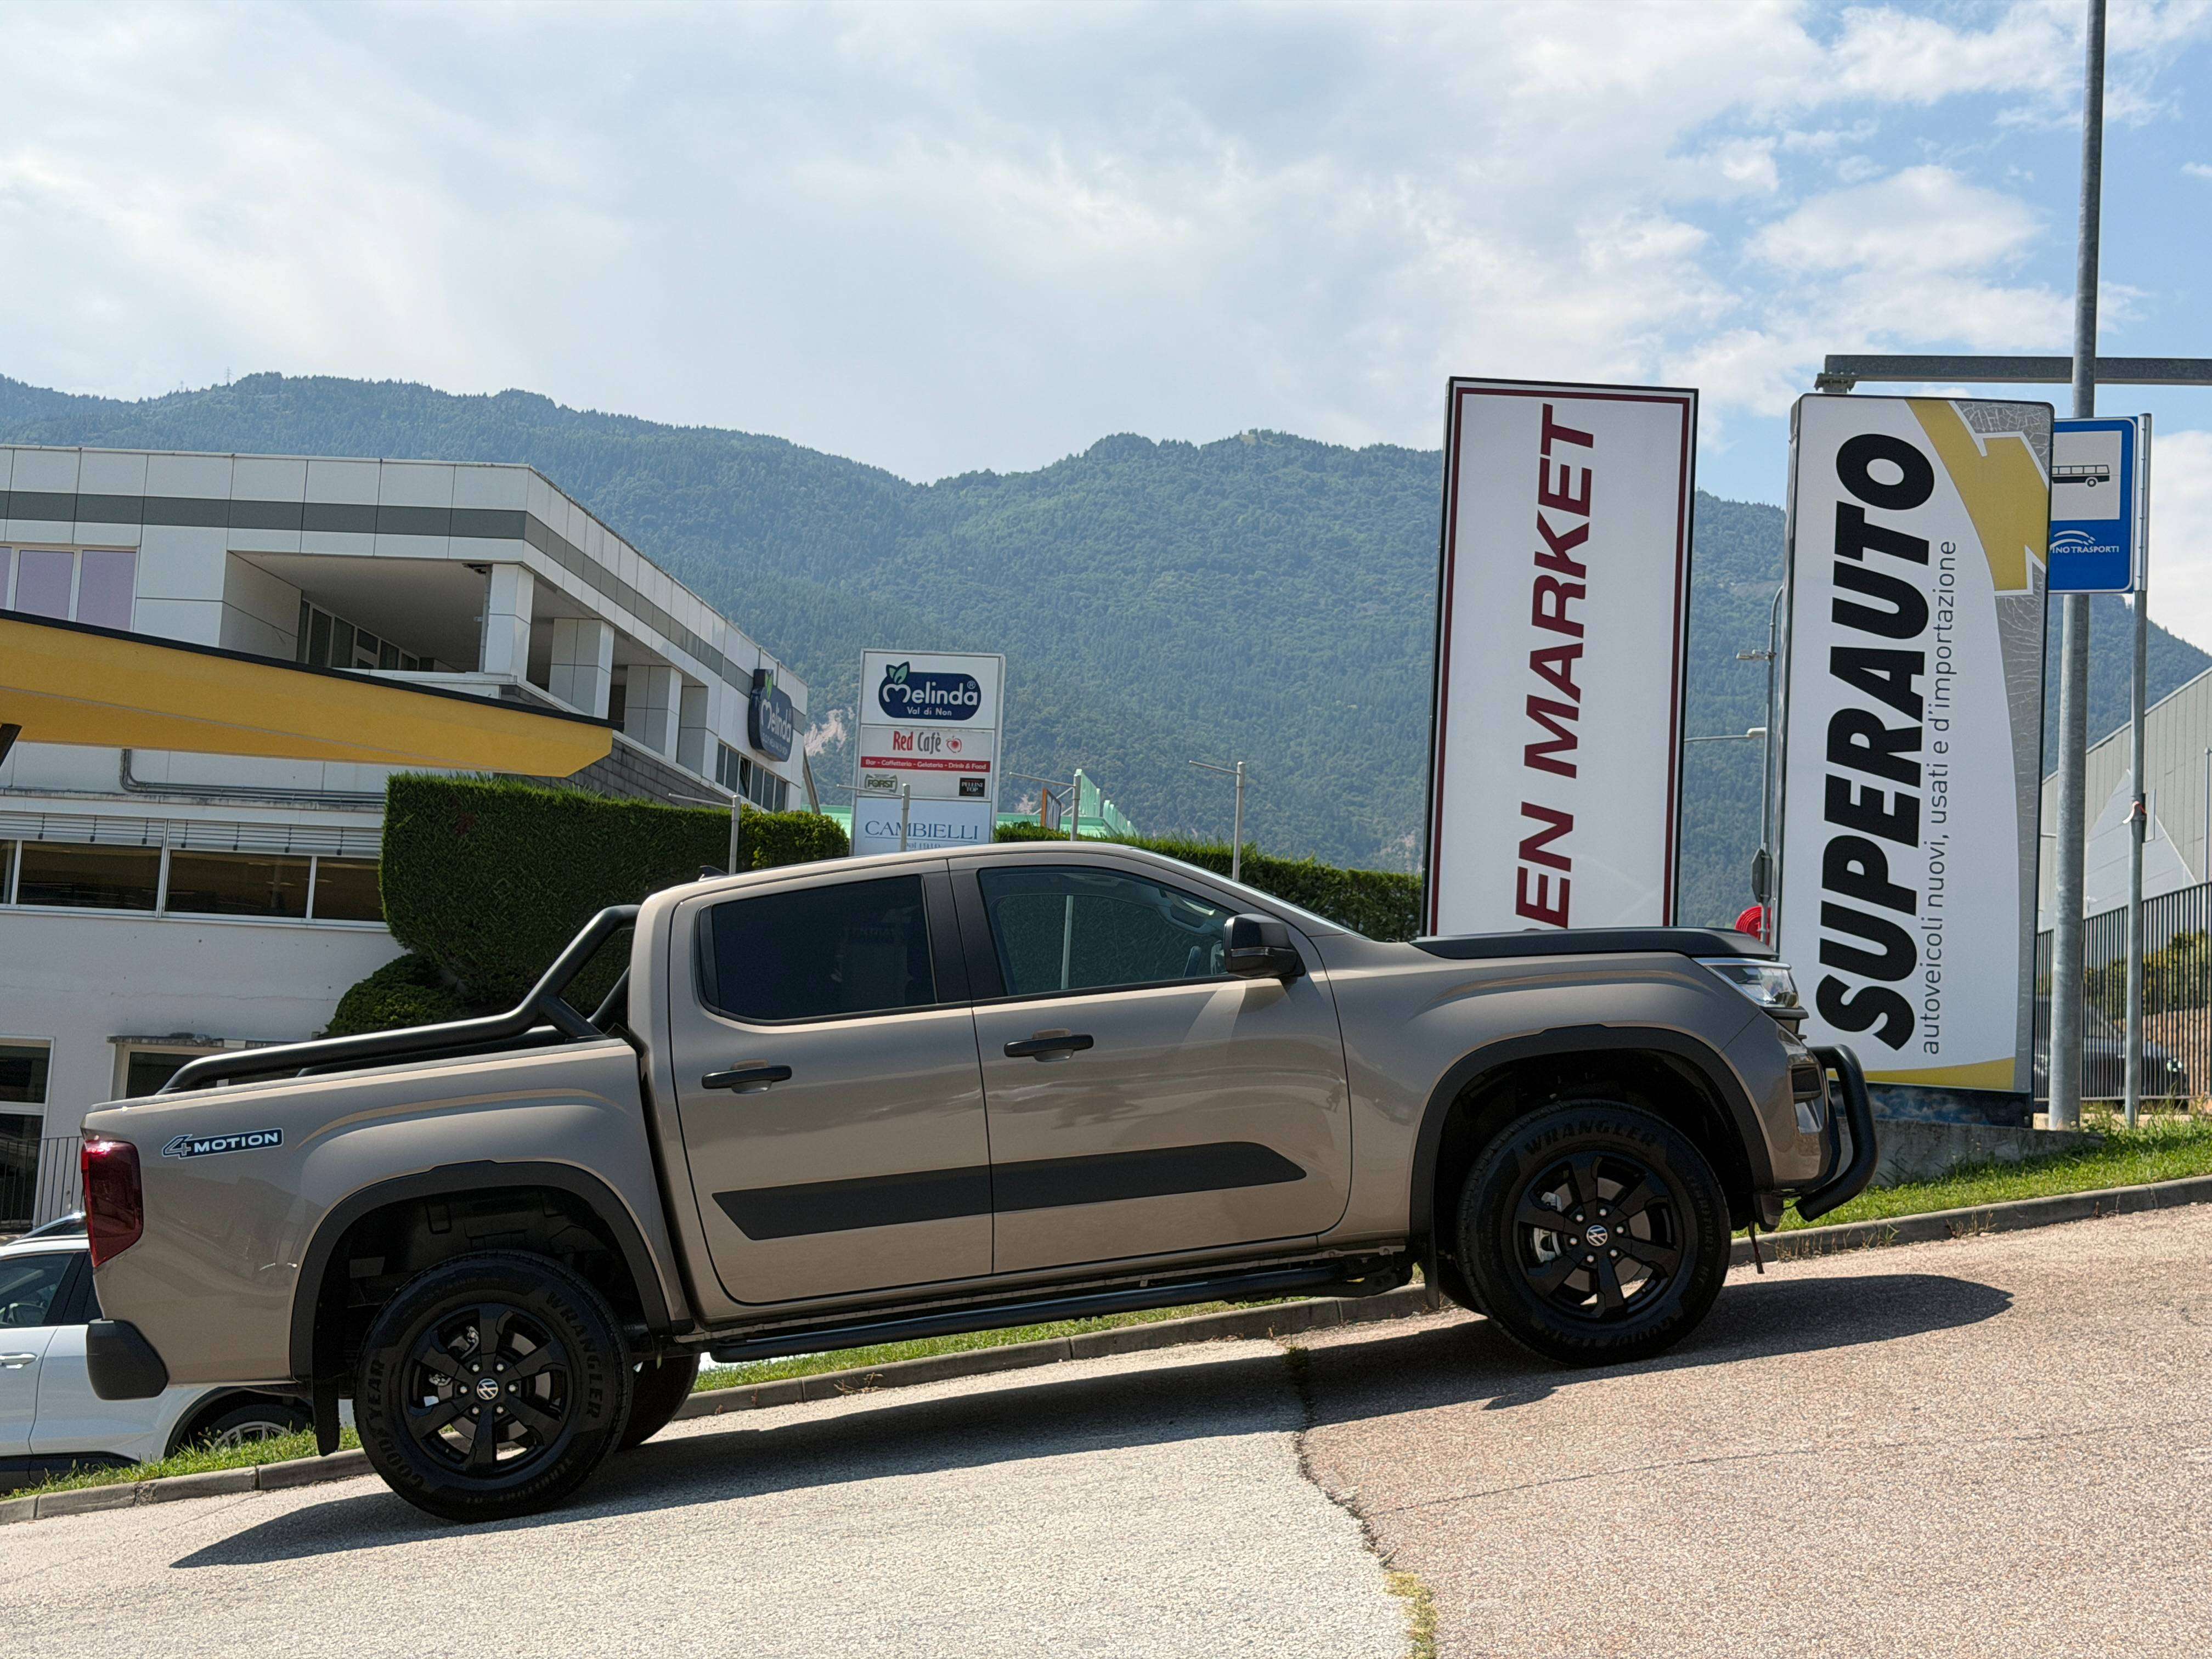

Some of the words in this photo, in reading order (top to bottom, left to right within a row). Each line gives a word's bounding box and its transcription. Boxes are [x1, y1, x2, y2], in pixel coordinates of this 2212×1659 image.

[2070, 545, 2119, 554] TRASPORTI
[1523, 402, 1594, 779] MARKET
[1928, 541, 1957, 731] d'importazione
[883, 681, 978, 706] Melinda
[760, 698, 791, 743] Melinda
[906, 707, 920, 715] Val
[924, 707, 932, 715] di
[935, 707, 952, 716] Non
[893, 730, 913, 752] Red
[917, 731, 942, 755] Cafè
[1815, 433, 1935, 1052] SUPERAUTO
[1933, 740, 1949, 754] e
[867, 779, 895, 788] FORST
[1926, 763, 1949, 824] usati
[865, 820, 979, 840] CAMBIELLI
[1515, 800, 1574, 932] EN
[1923, 834, 1950, 908] nuovi,
[1920, 917, 1944, 1054] autoveicoli
[164, 1132, 278, 1156] 4MOTION
